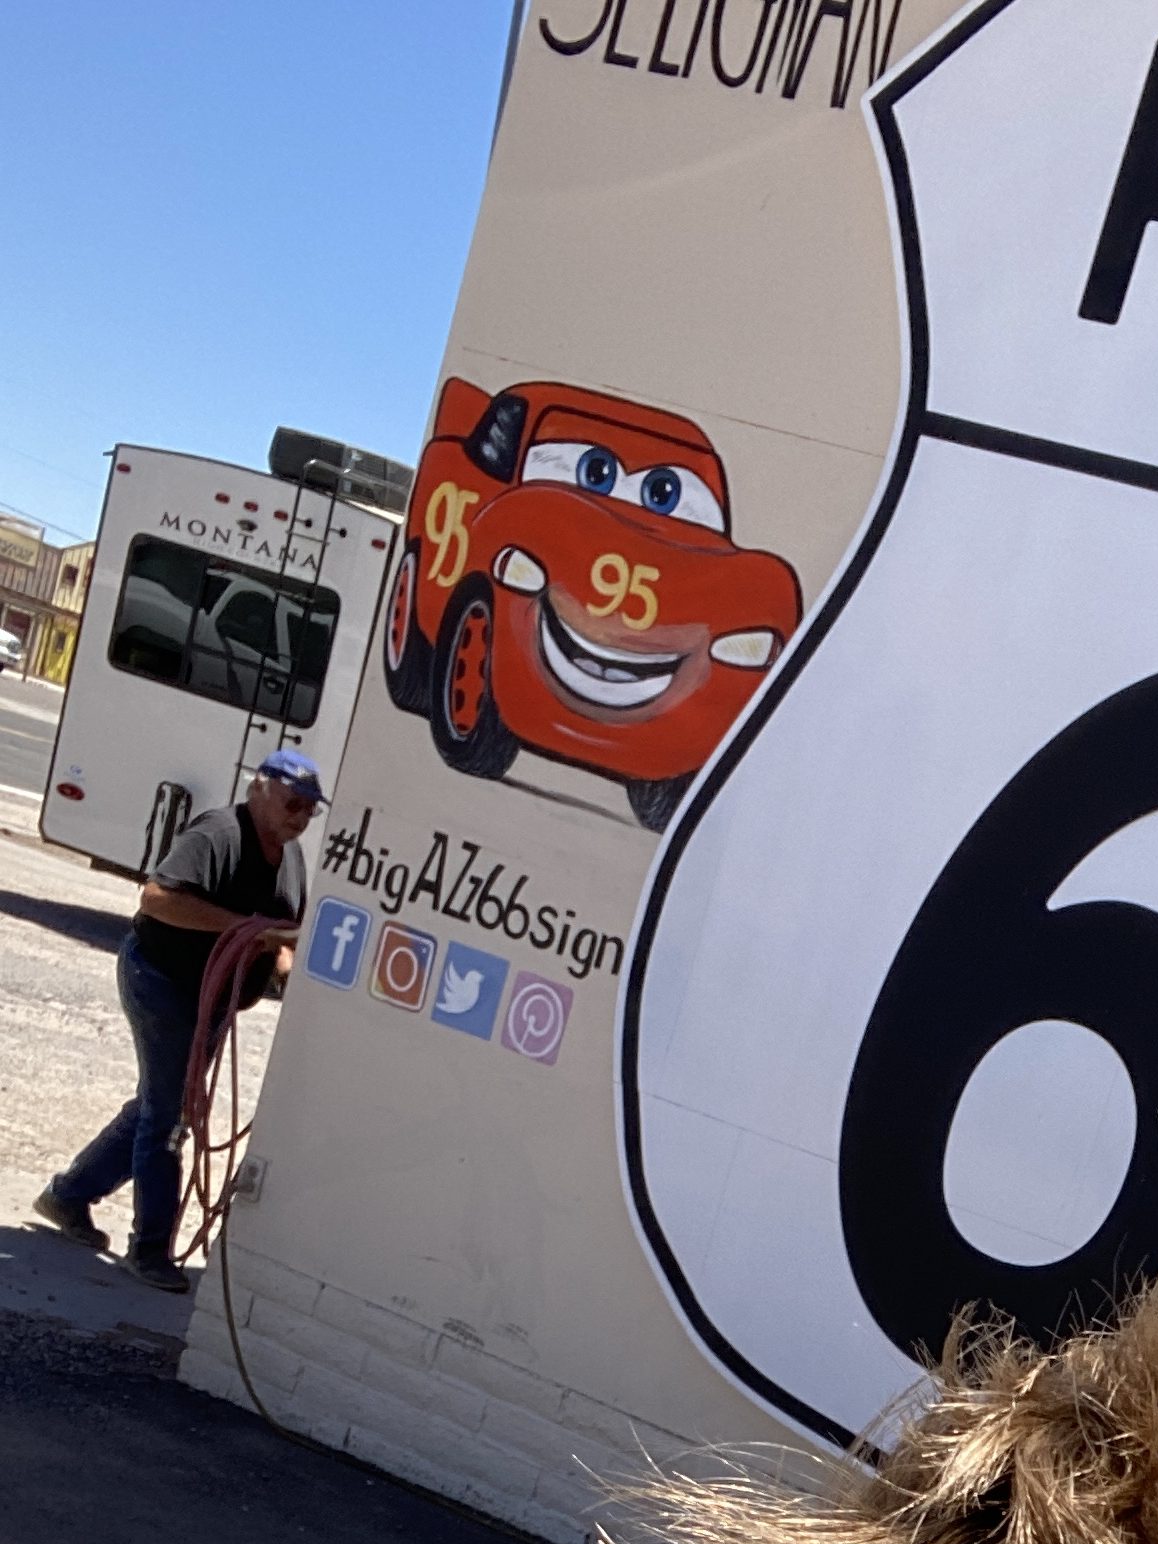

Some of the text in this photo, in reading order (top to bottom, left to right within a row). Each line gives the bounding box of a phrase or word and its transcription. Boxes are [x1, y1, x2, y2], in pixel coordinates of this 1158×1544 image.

[159, 511, 318, 571] MONTANA
[425, 481, 480, 588] 95
[585, 553, 662, 631] 95
